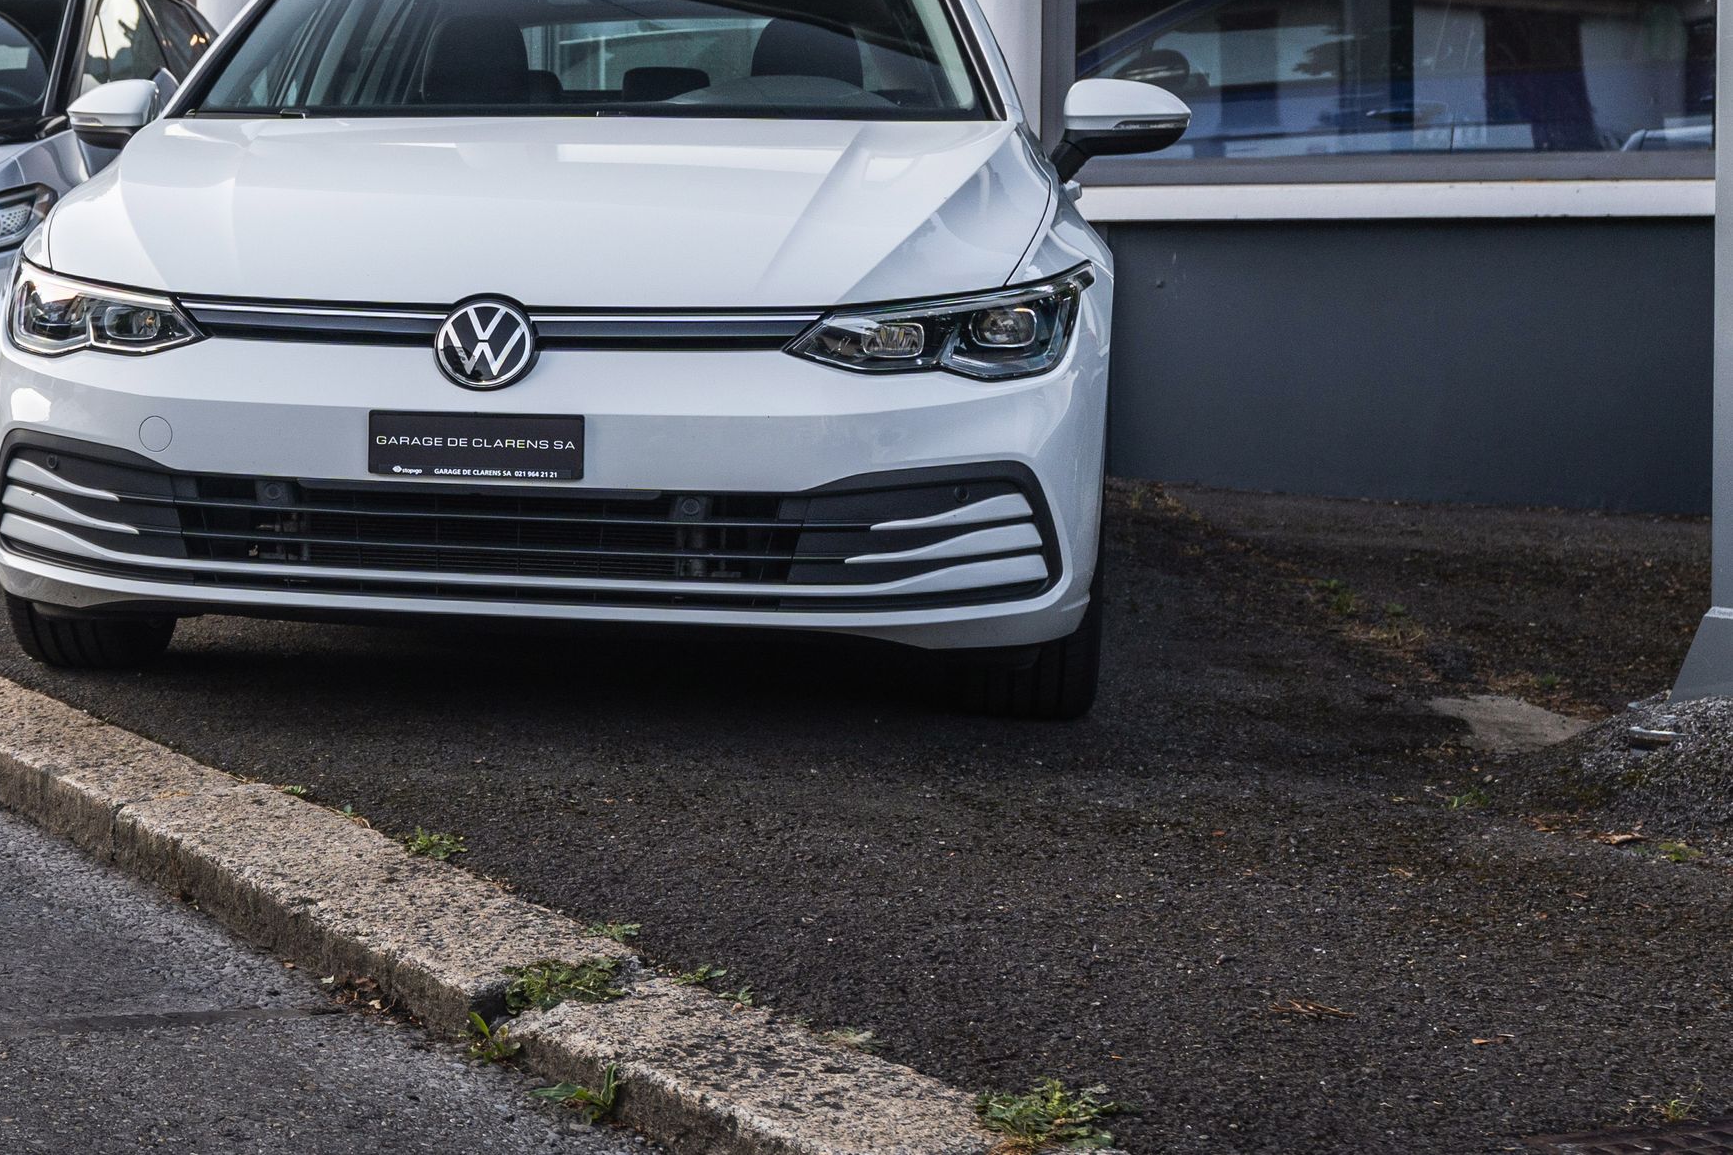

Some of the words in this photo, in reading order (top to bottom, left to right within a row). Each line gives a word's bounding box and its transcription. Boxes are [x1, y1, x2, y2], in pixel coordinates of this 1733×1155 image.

[375, 435, 443, 447] GARAGE
[447, 437, 468, 448] DE
[472, 438, 549, 450] CLARENS
[553, 440, 576, 450] SA
[462, 468, 472, 476] DE
